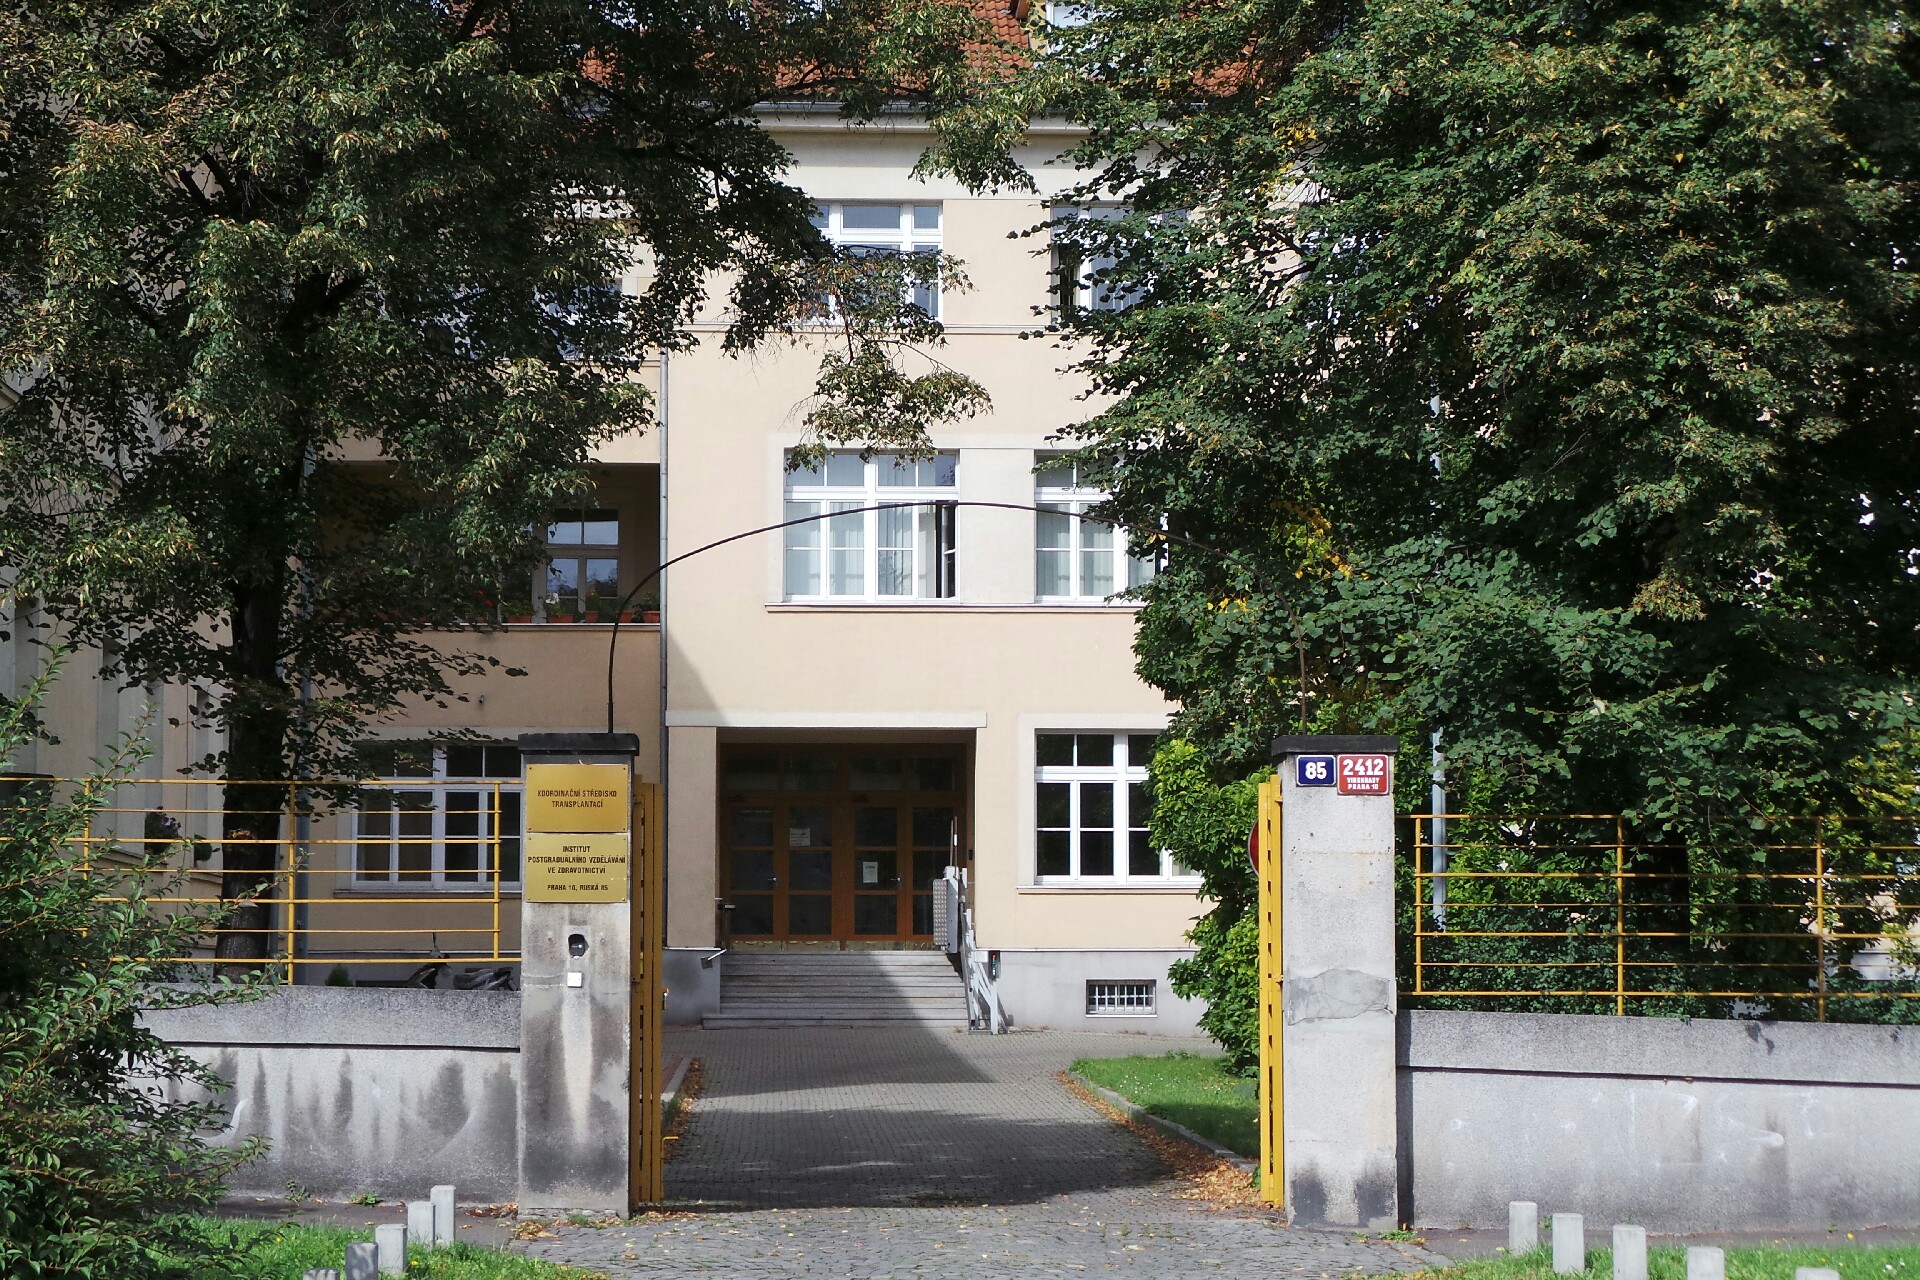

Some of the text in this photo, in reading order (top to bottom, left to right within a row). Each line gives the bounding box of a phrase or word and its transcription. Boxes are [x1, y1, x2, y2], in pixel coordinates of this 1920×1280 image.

[1305, 761, 1327, 780] 85
[1342, 758, 1384, 776] 2412
[537, 788, 617, 798] KOORDINAČNÍ STŘEDISKO
[552, 799, 604, 808] TRANSPLANTACÍ
[528, 855, 626, 864] POSTGRADUÁLNÍHO VZDĚLÁVÁNÍ
[558, 866, 606, 874] ZDRAVOTNICTVÍ
